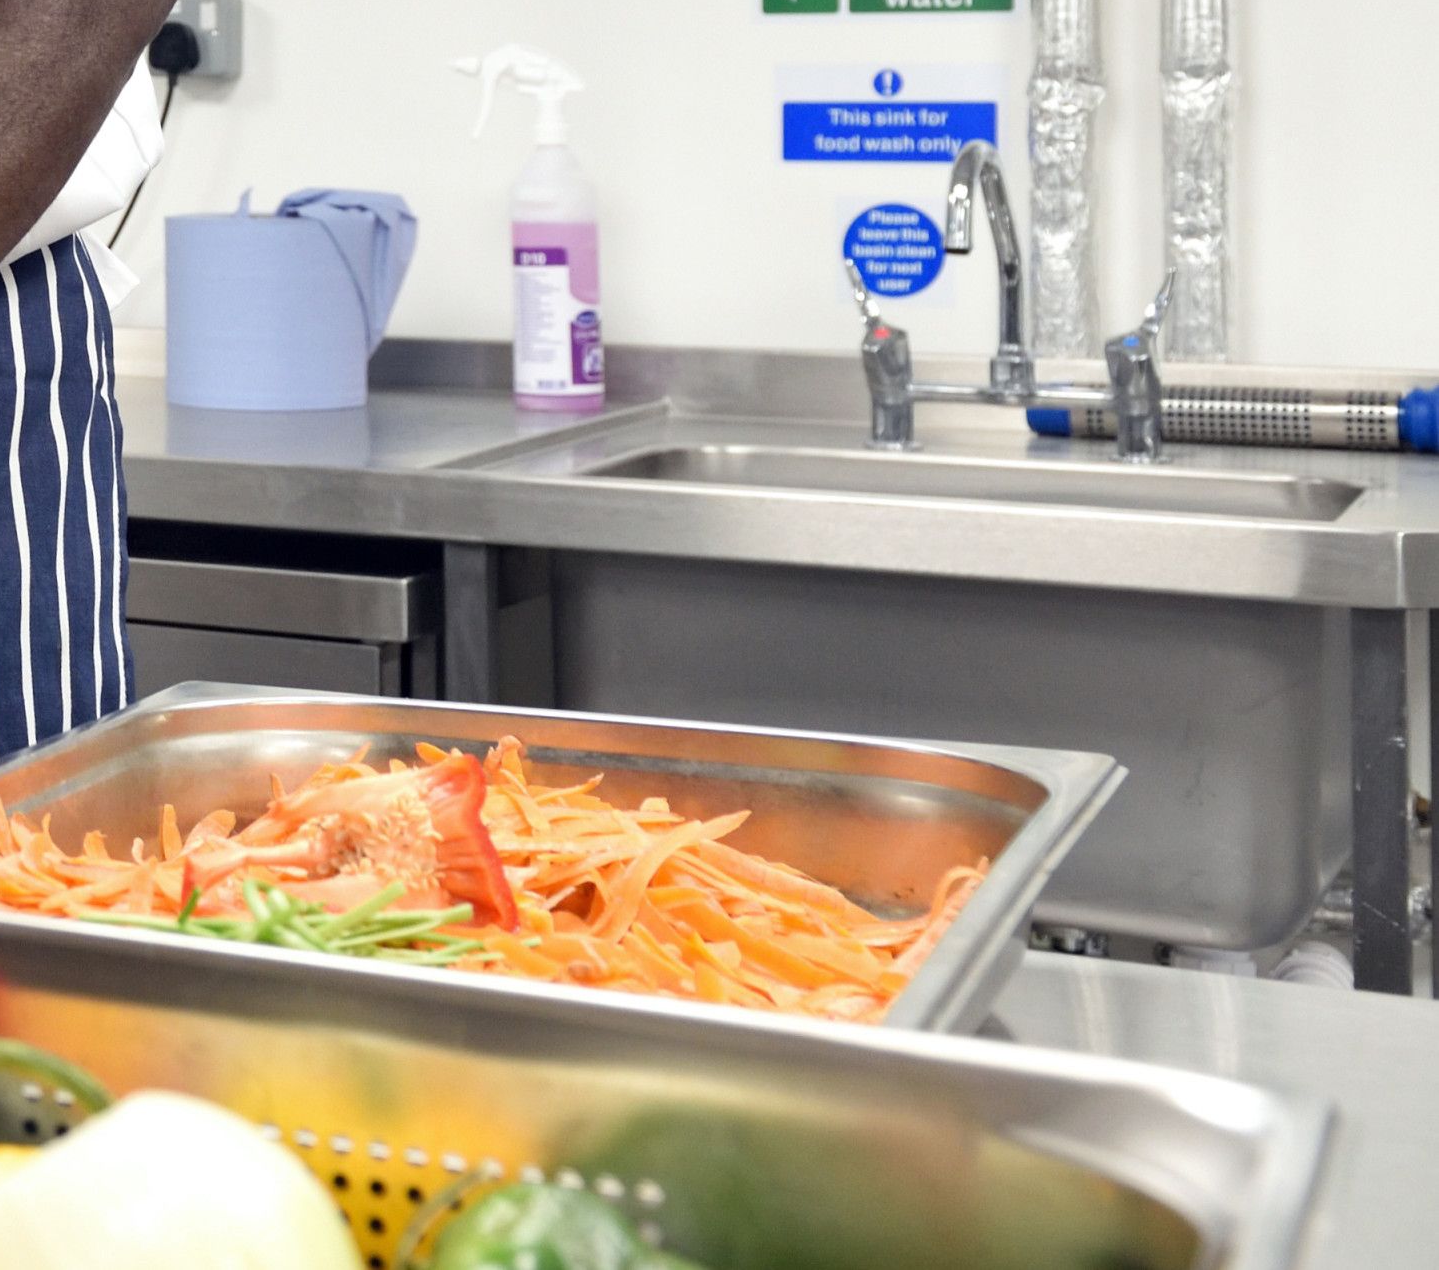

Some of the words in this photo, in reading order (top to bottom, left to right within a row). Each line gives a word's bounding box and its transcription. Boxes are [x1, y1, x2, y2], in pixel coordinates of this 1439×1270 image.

[828, 107, 871, 127] This
[873, 107, 916, 127] sink
[918, 107, 949, 127] for
[813, 133, 861, 152] food
[863, 134, 915, 153] wash
[917, 134, 962, 156] only
[867, 210, 920, 226] Please
[857, 226, 899, 242] leave
[901, 227, 930, 242] this
[851, 243, 894, 258] basin
[895, 243, 937, 259] clean
[865, 259, 887, 274] for
[891, 260, 922, 275] next
[876, 278, 912, 292] user
